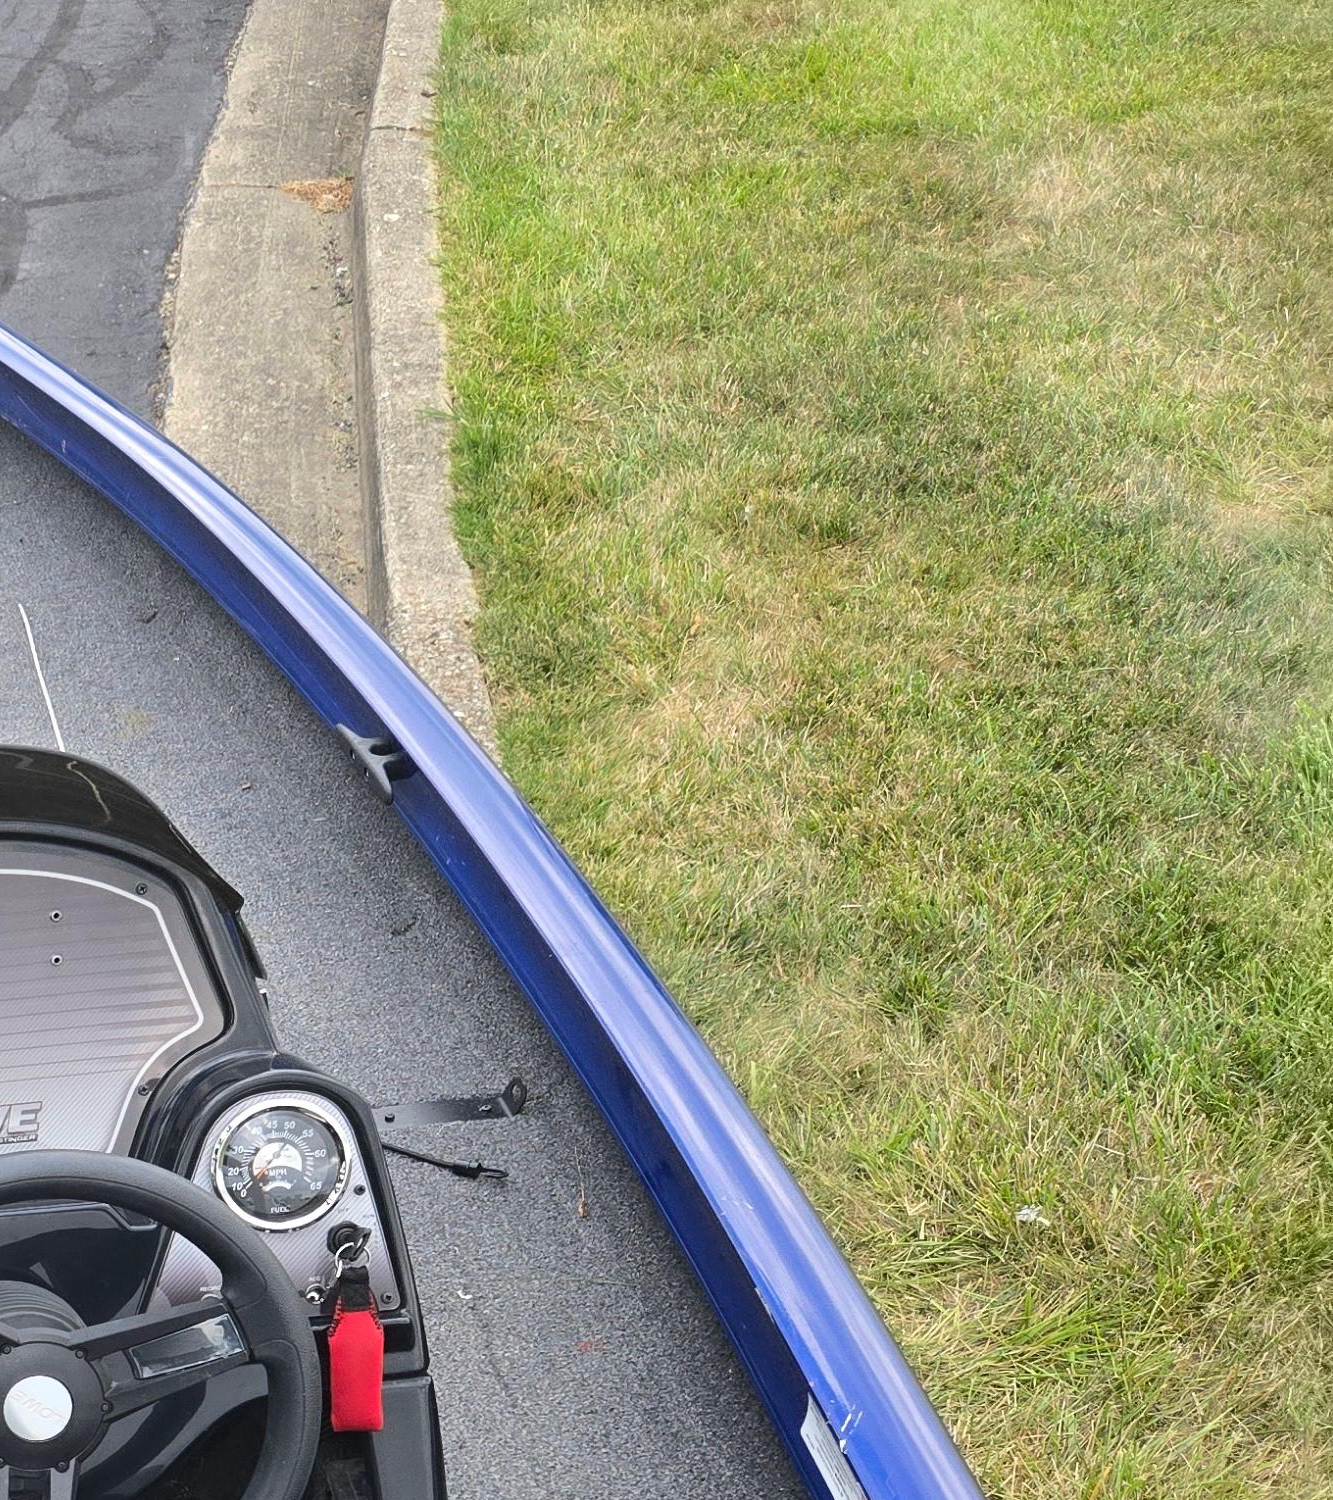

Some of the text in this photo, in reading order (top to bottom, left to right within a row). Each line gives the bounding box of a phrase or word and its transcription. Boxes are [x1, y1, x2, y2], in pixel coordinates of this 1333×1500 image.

[266, 1121, 278, 1129] 45
[284, 1121, 296, 1129] 50
[302, 1129, 314, 1138] 55
[232, 1146, 244, 1154] 30
[314, 1150, 326, 1158] 60
[228, 1167, 240, 1176] 20
[232, 1182, 243, 1191] 10
[310, 1182, 322, 1190] 65
[240, 1190, 247, 1198] 0
